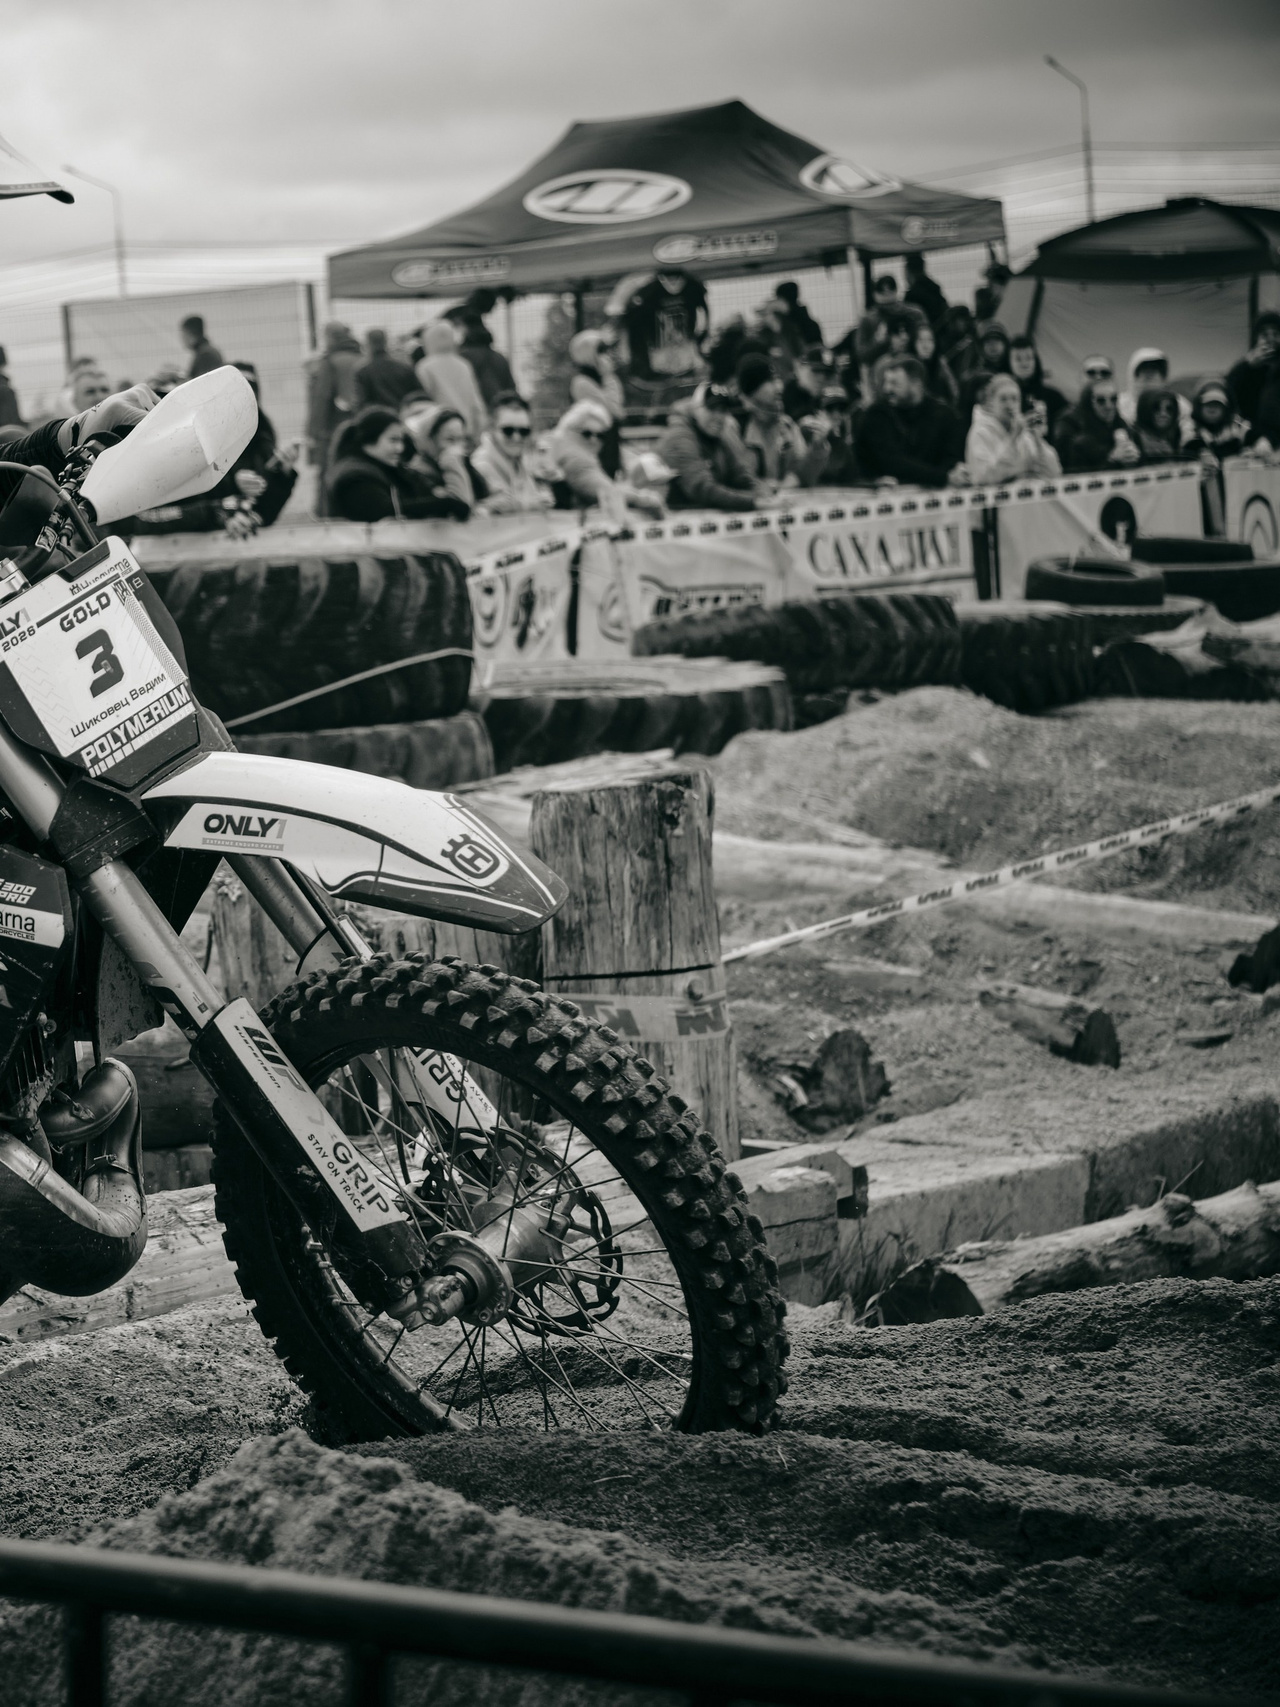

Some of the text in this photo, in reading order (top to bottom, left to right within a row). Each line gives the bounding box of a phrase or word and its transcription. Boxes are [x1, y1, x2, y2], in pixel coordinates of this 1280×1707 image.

[59, 591, 112, 633] GOLD
[75, 628, 126, 699] 3
[70, 673, 167, 738] Шиковец Вадим
[80, 683, 191, 768] POLYMERIUM
[307, 1133, 366, 1214] STAY ON TRACK
[332, 1141, 390, 1214] GRIP
